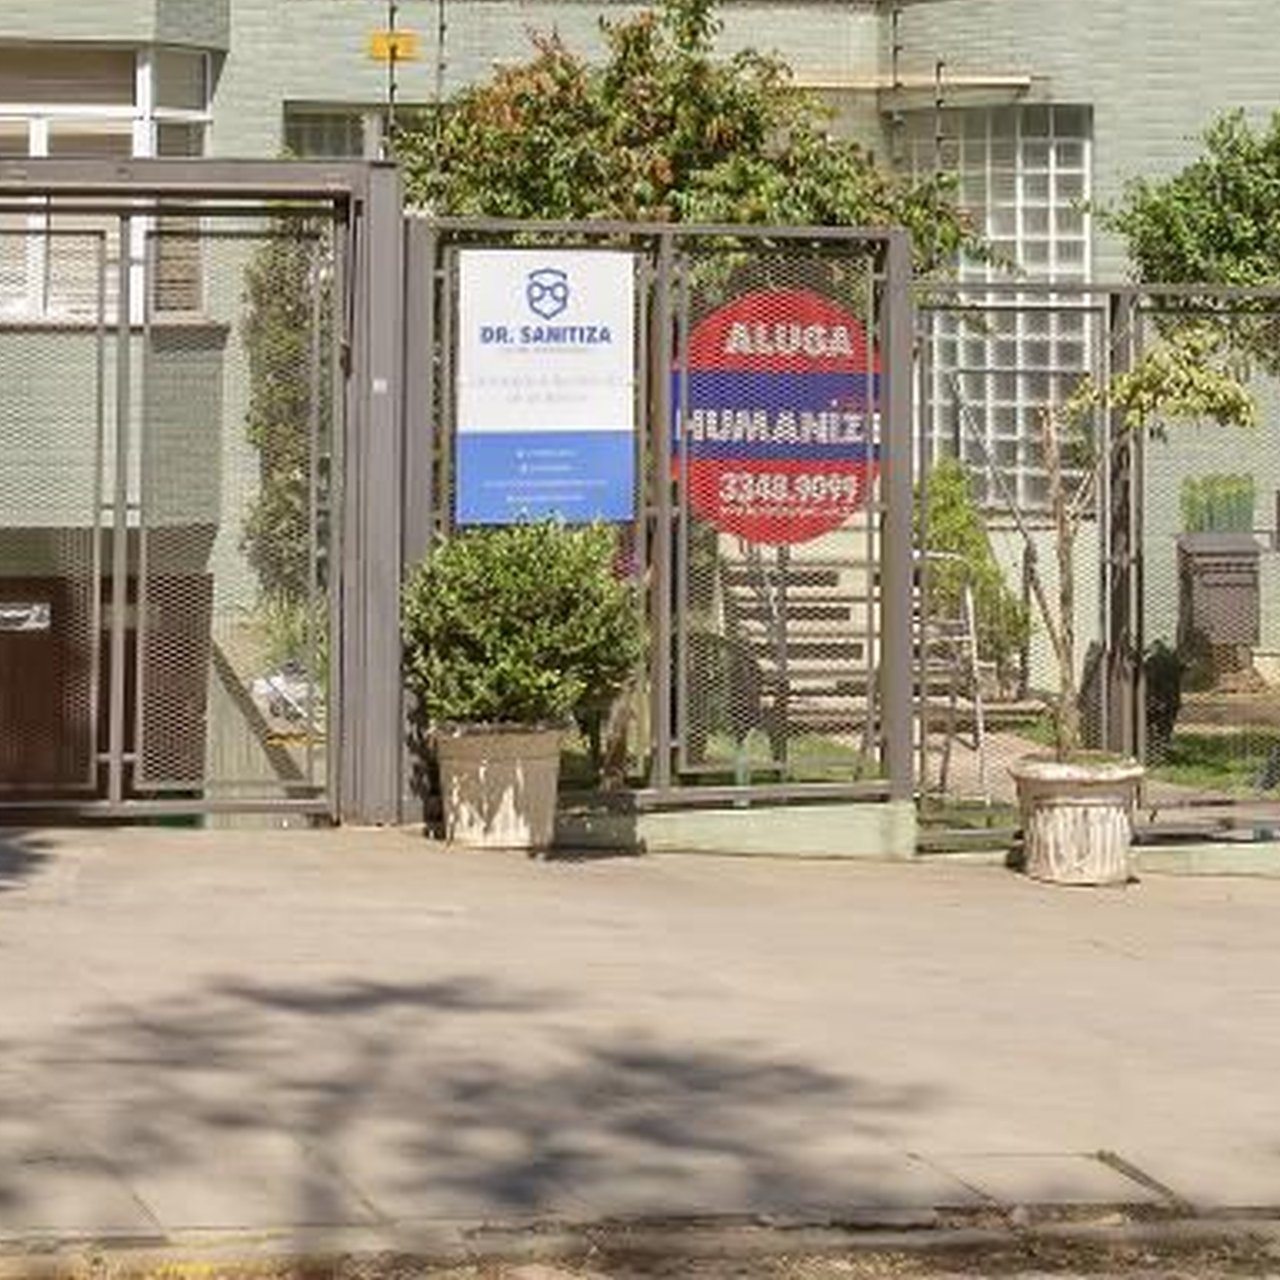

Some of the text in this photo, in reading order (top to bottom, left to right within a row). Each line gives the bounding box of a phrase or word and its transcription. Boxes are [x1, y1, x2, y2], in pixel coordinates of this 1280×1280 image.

[480, 326, 612, 345] DR. SANITIZA
[725, 322, 853, 358] ALUGA
